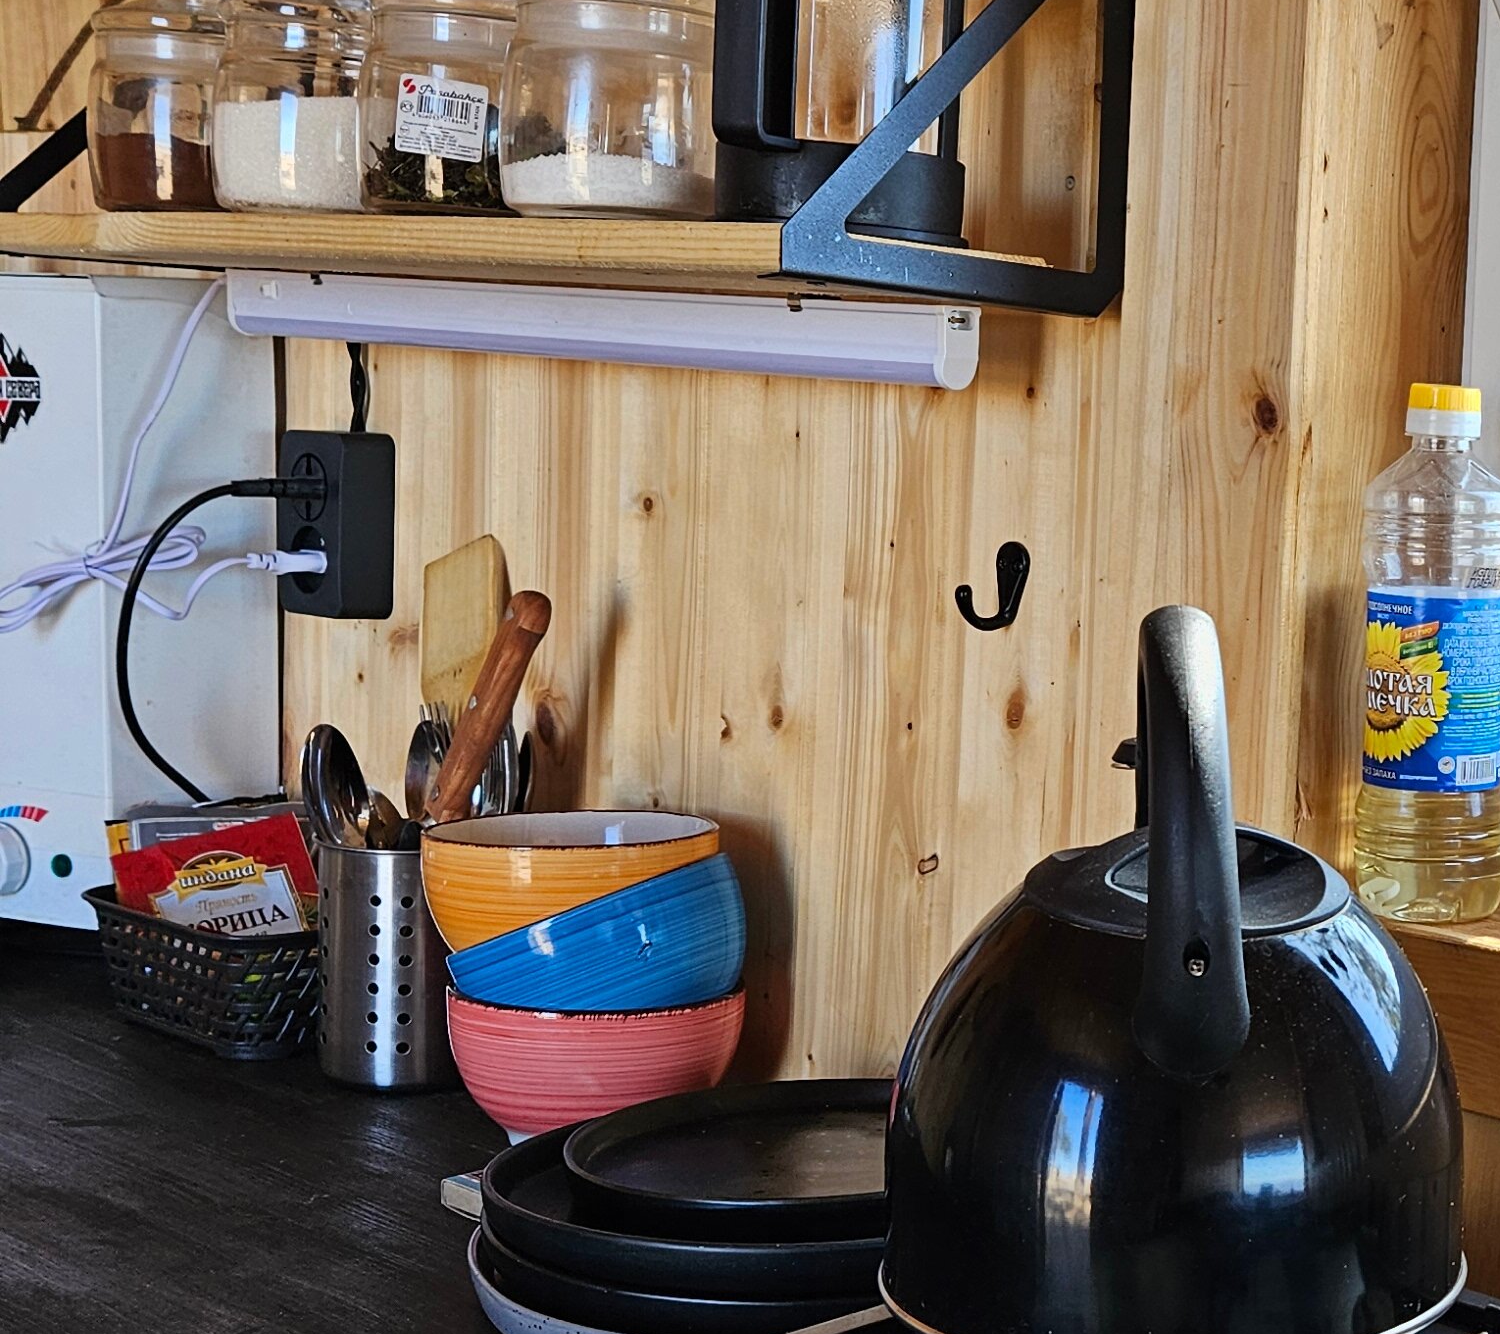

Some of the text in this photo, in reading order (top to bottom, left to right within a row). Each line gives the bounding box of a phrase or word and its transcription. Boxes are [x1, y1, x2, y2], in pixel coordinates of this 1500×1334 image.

[1373, 768, 1397, 780] ЗАПАХА
[180, 863, 256, 888] индана
[197, 895, 258, 916] Пряность
[188, 903, 290, 933] ОРИЦА
